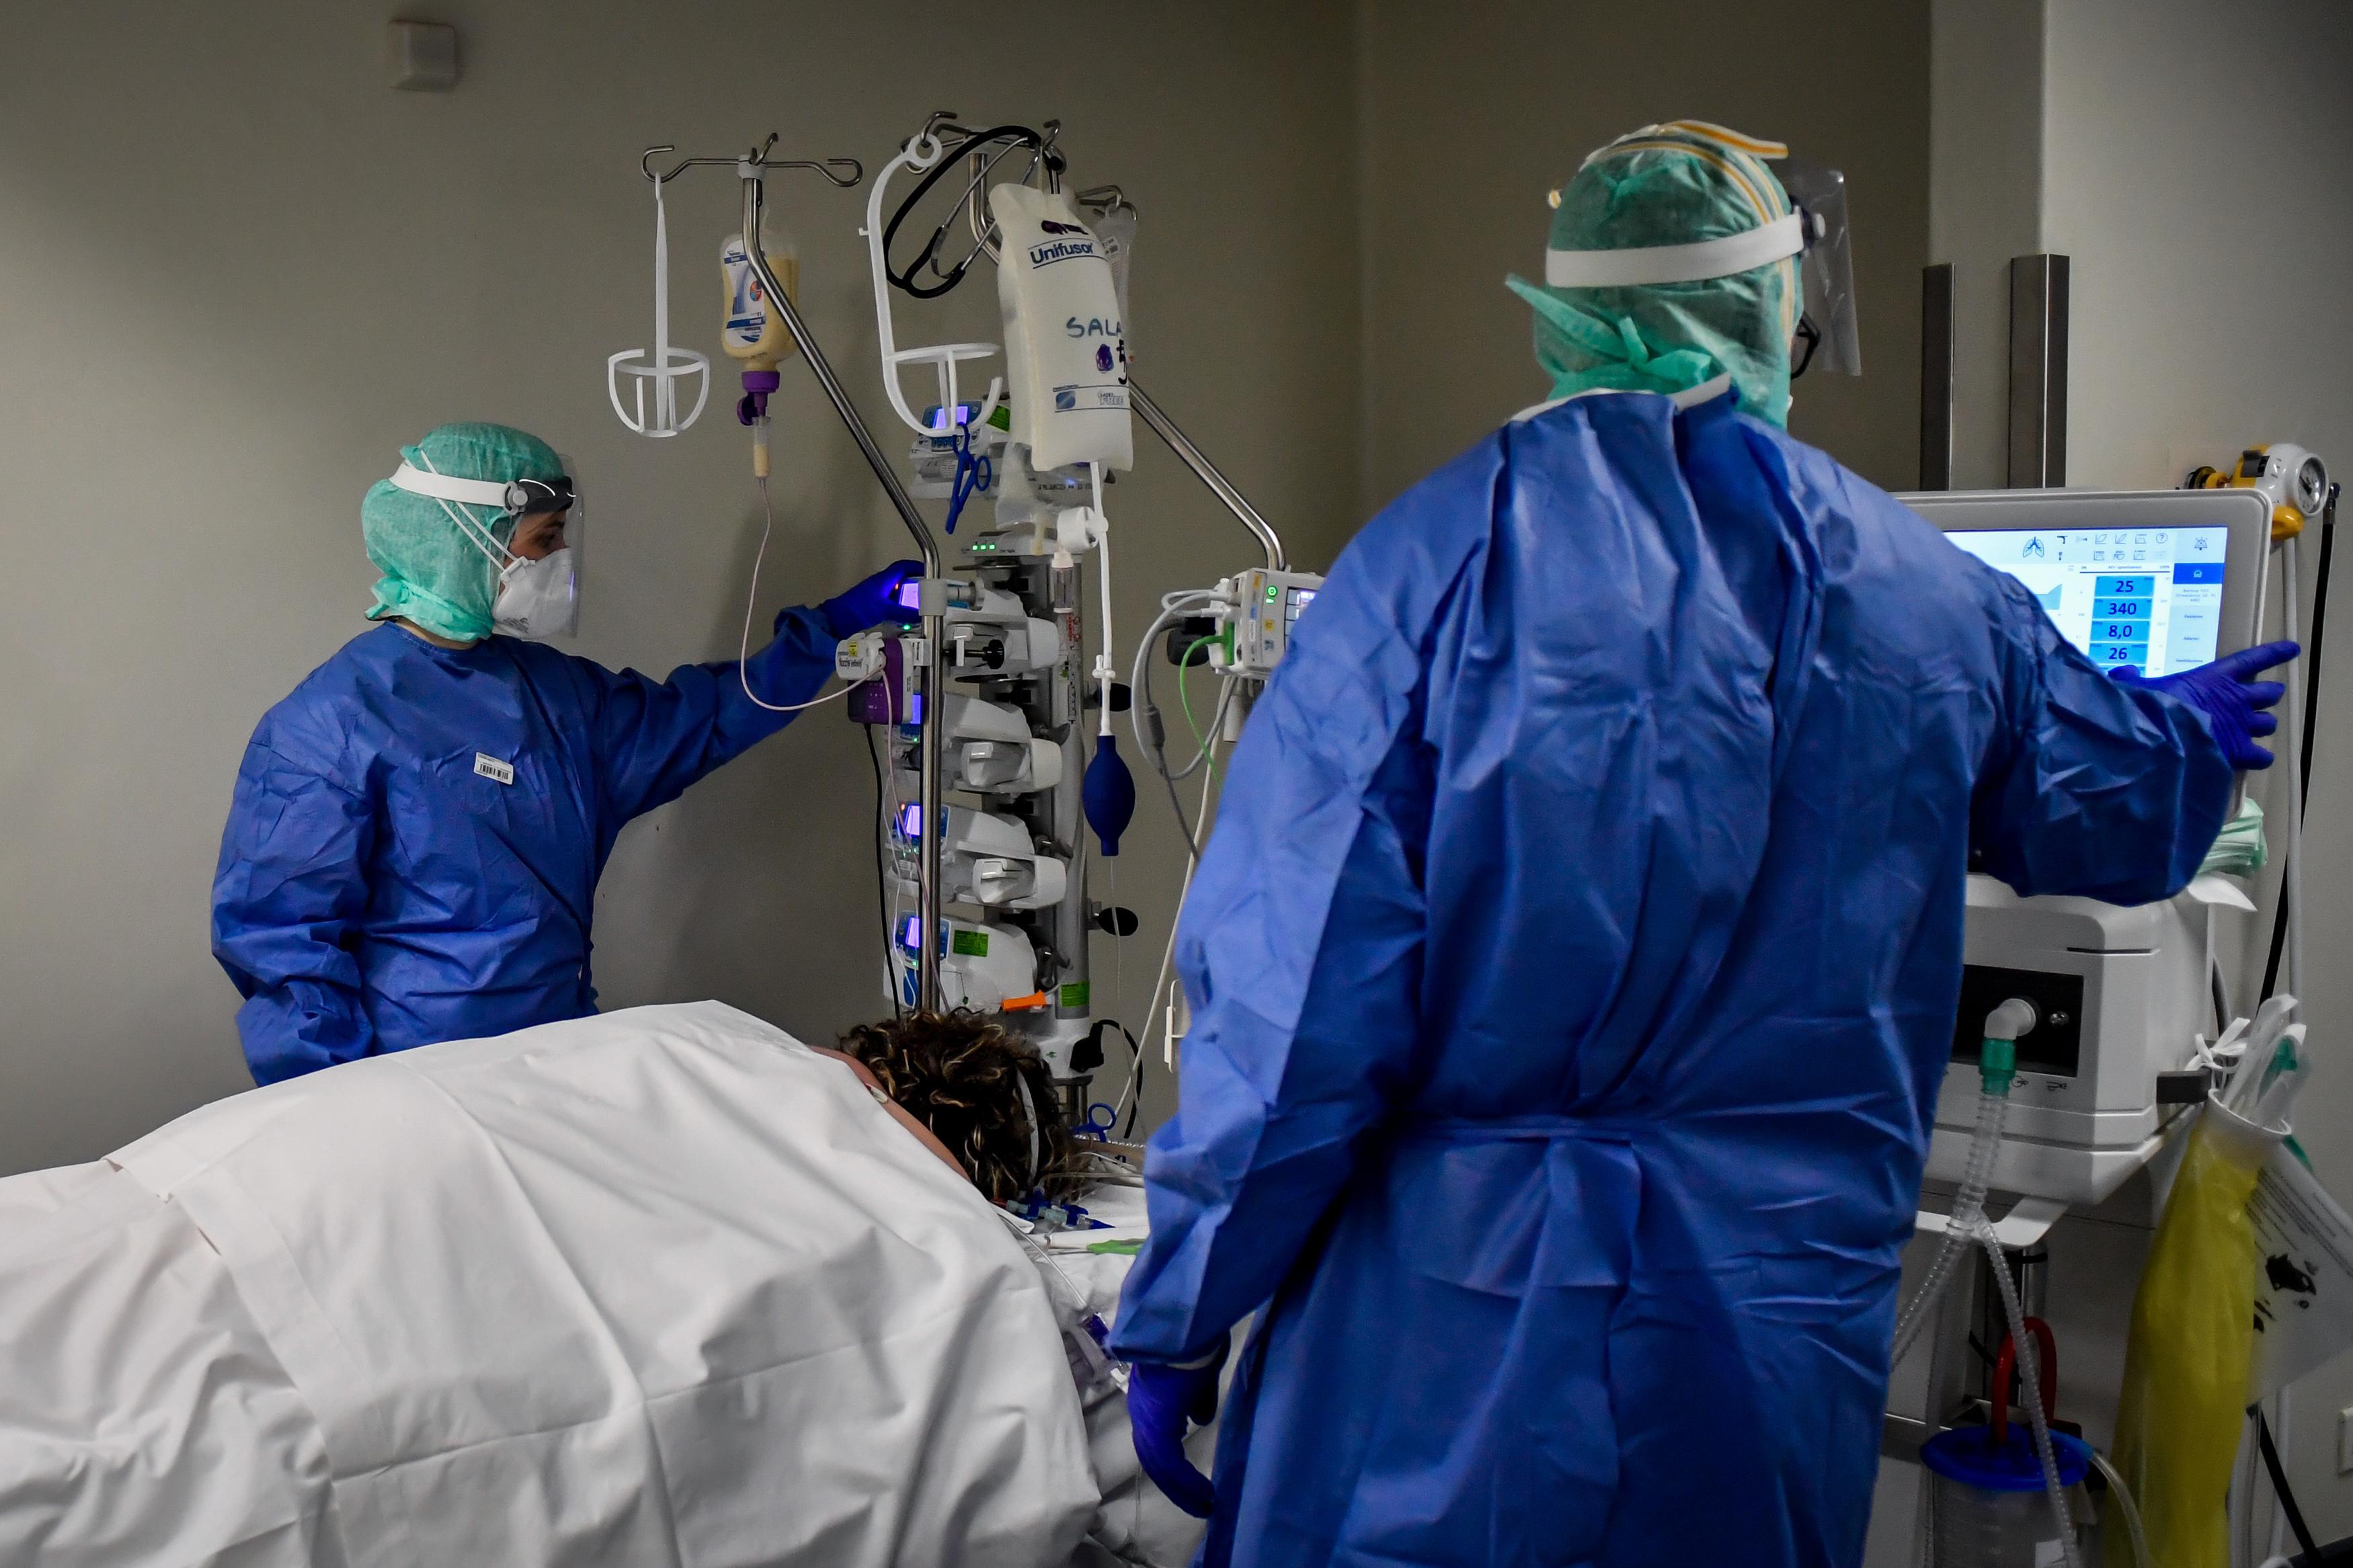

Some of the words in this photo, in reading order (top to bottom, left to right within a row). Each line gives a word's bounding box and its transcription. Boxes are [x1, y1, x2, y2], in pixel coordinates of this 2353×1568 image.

[1030, 243, 1093, 264] Unifusor
[2115, 580, 2134, 593] 25
[2108, 602, 2137, 615] 340
[2108, 625, 2132, 639] 8,0
[2108, 647, 2128, 660] 26
